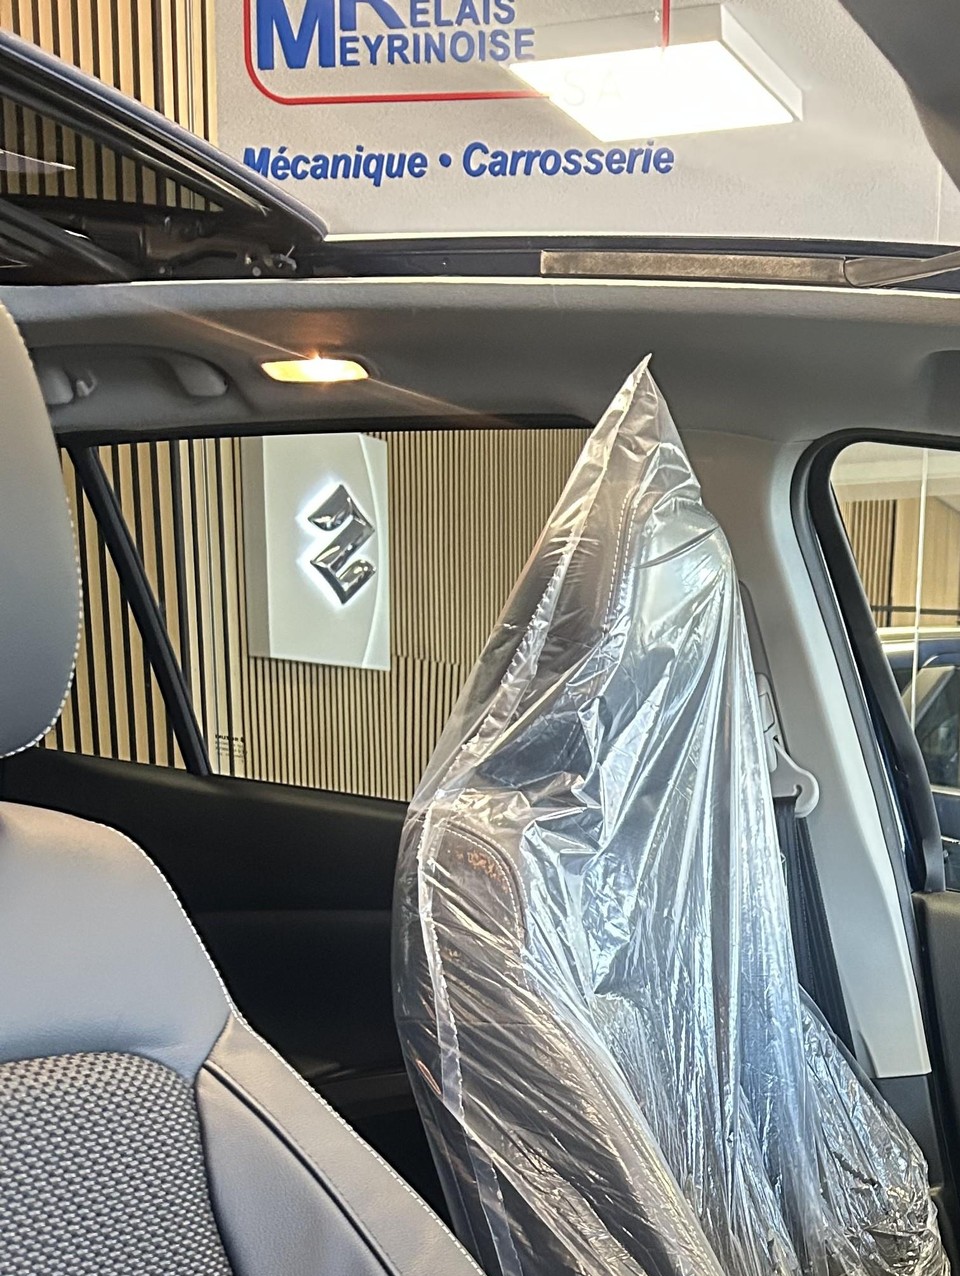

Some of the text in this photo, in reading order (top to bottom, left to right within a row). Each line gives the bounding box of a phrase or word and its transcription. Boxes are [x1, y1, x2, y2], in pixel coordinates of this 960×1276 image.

[256, 0, 535, 70] MEYRINOISE
[243, 139, 675, 188] Mécanique Carrosserie
